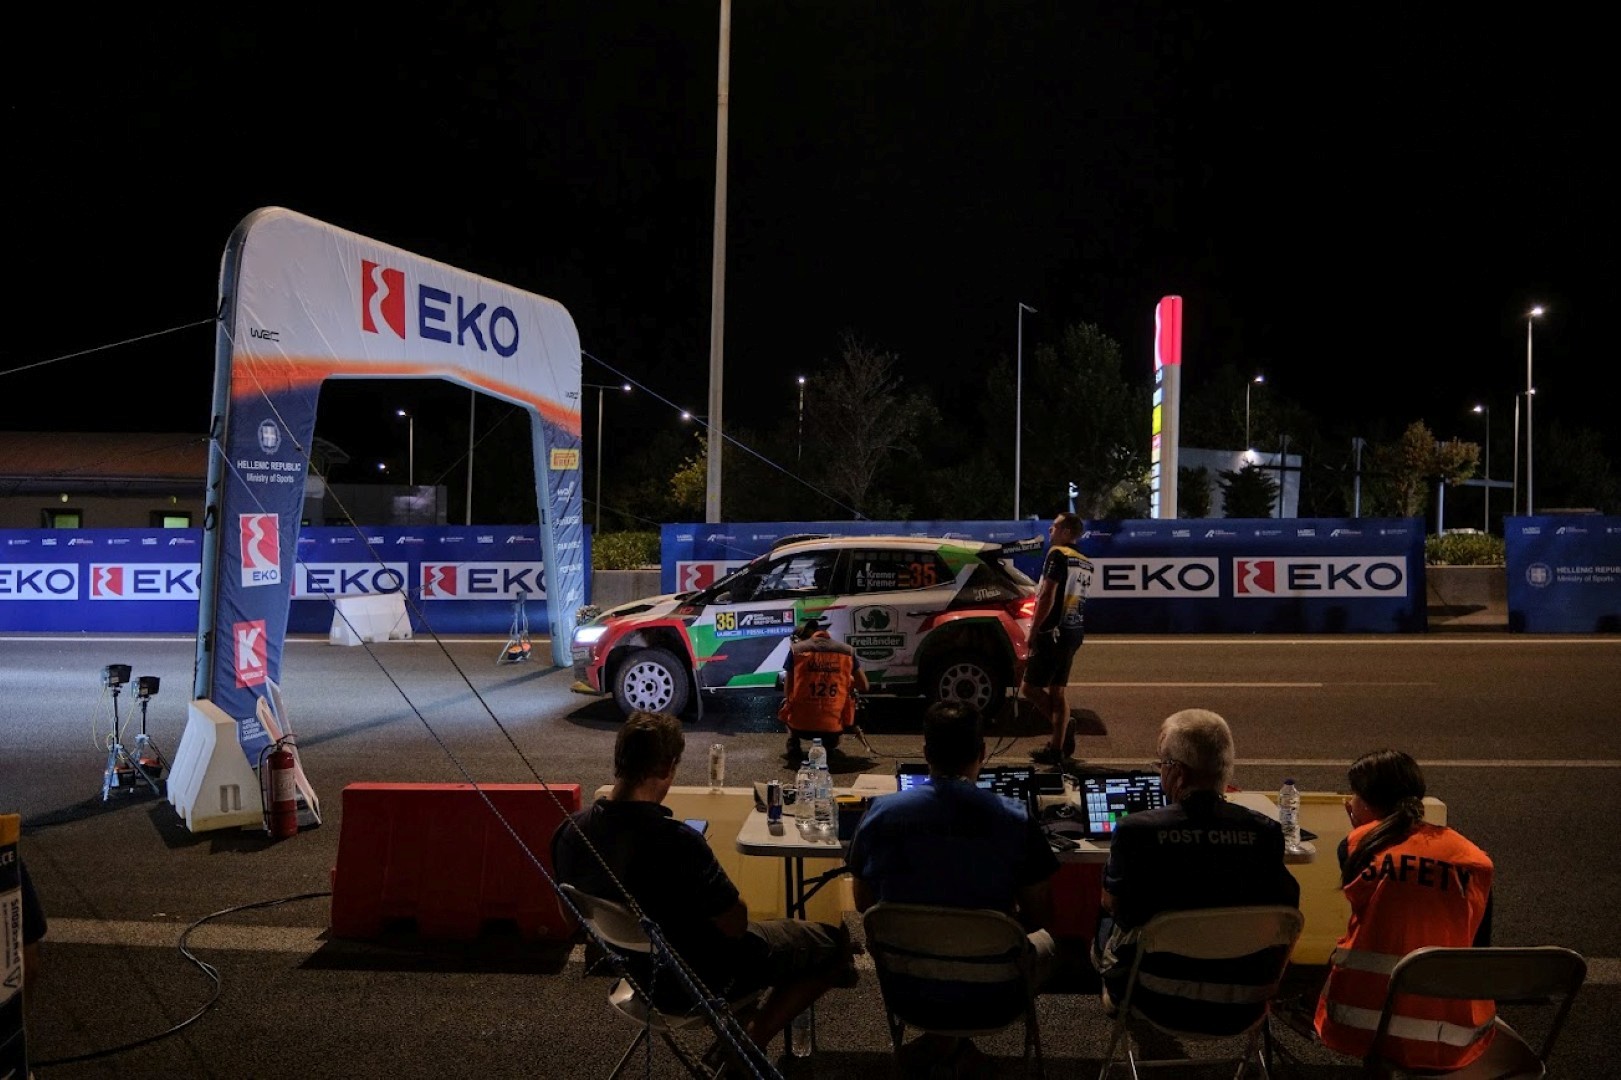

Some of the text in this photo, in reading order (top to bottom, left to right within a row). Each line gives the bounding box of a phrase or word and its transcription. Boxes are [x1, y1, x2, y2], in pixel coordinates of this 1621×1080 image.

[418, 283, 519, 358] EKO
[250, 327, 280, 342] WRC
[237, 460, 302, 472] HELLENIC REPUBLIC
[246, 472, 294, 484] Ministry of Sports
[252, 570, 278, 581] EKO
[856, 570, 897, 579] A. Kremer
[909, 563, 937, 588] 35
[1103, 563, 1215, 592] EKO
[1289, 562, 1403, 592] EKO
[1556, 566, 1621, 574] HELLENIC REPUB
[134, 569, 202, 594] EK
[306, 569, 405, 594] EKO
[468, 568, 546, 594] EK
[866, 579, 896, 588] Kremer
[1557, 575, 1583, 584] Ministry
[1592, 575, 1614, 584] Sports
[716, 612, 735, 631] 35
[238, 628, 262, 671] K
[809, 682, 838, 698] 126
[1156, 829, 1257, 846] POST CHIEF
[1361, 853, 1471, 893] SAFETY
